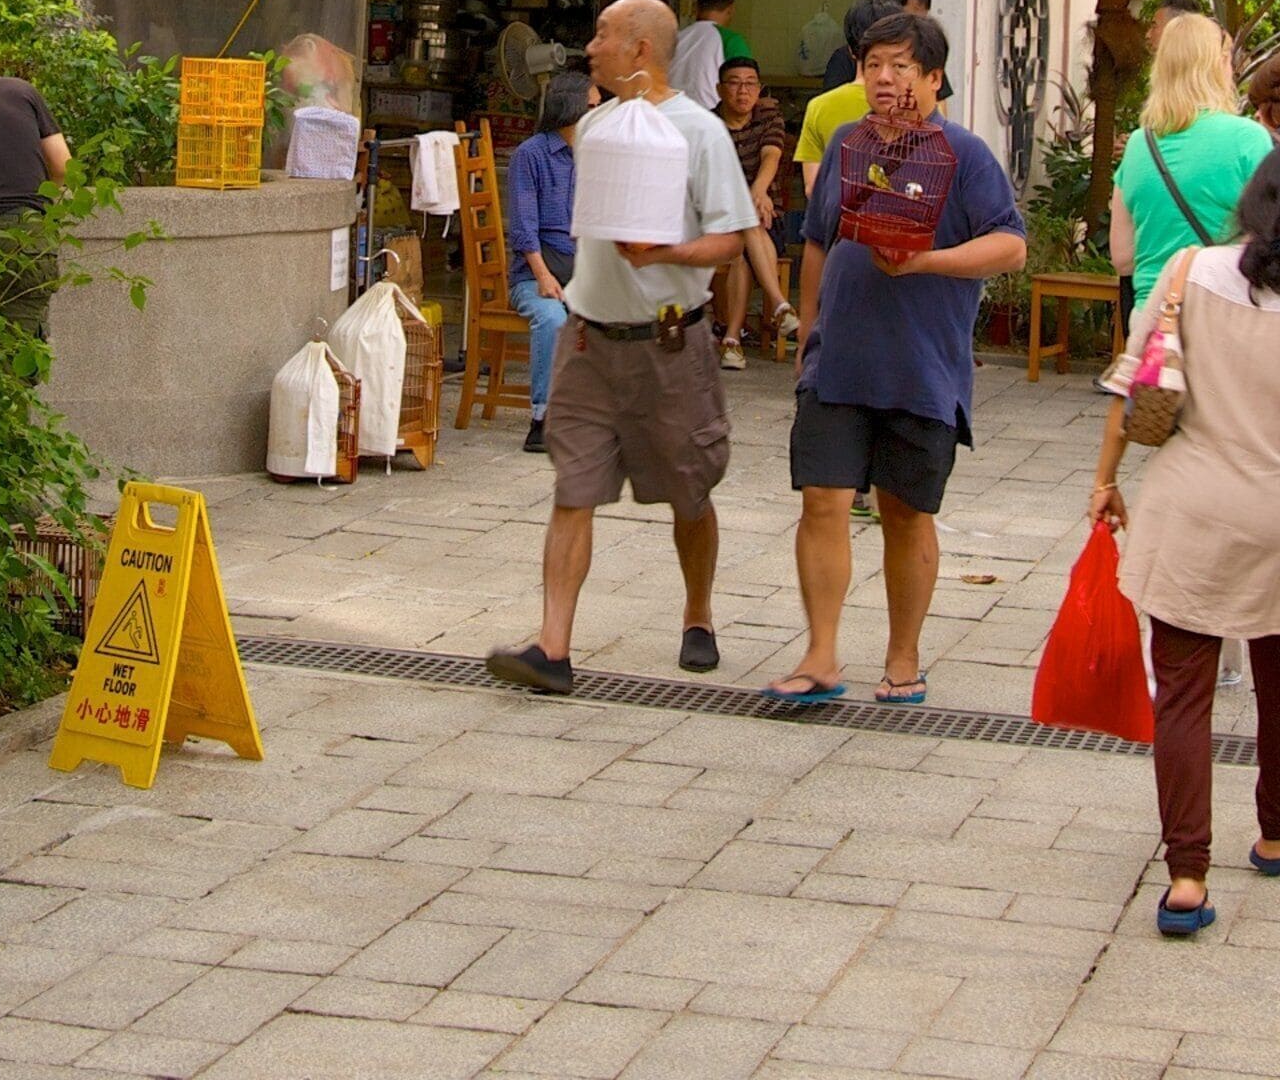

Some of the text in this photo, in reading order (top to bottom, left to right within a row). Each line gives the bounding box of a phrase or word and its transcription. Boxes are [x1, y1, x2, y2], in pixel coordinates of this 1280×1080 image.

[121, 548, 174, 573] CAUTION
[113, 663, 136, 680] WET
[103, 678, 137, 697] FLOOR
[76, 698, 151, 732] 小心地滑
